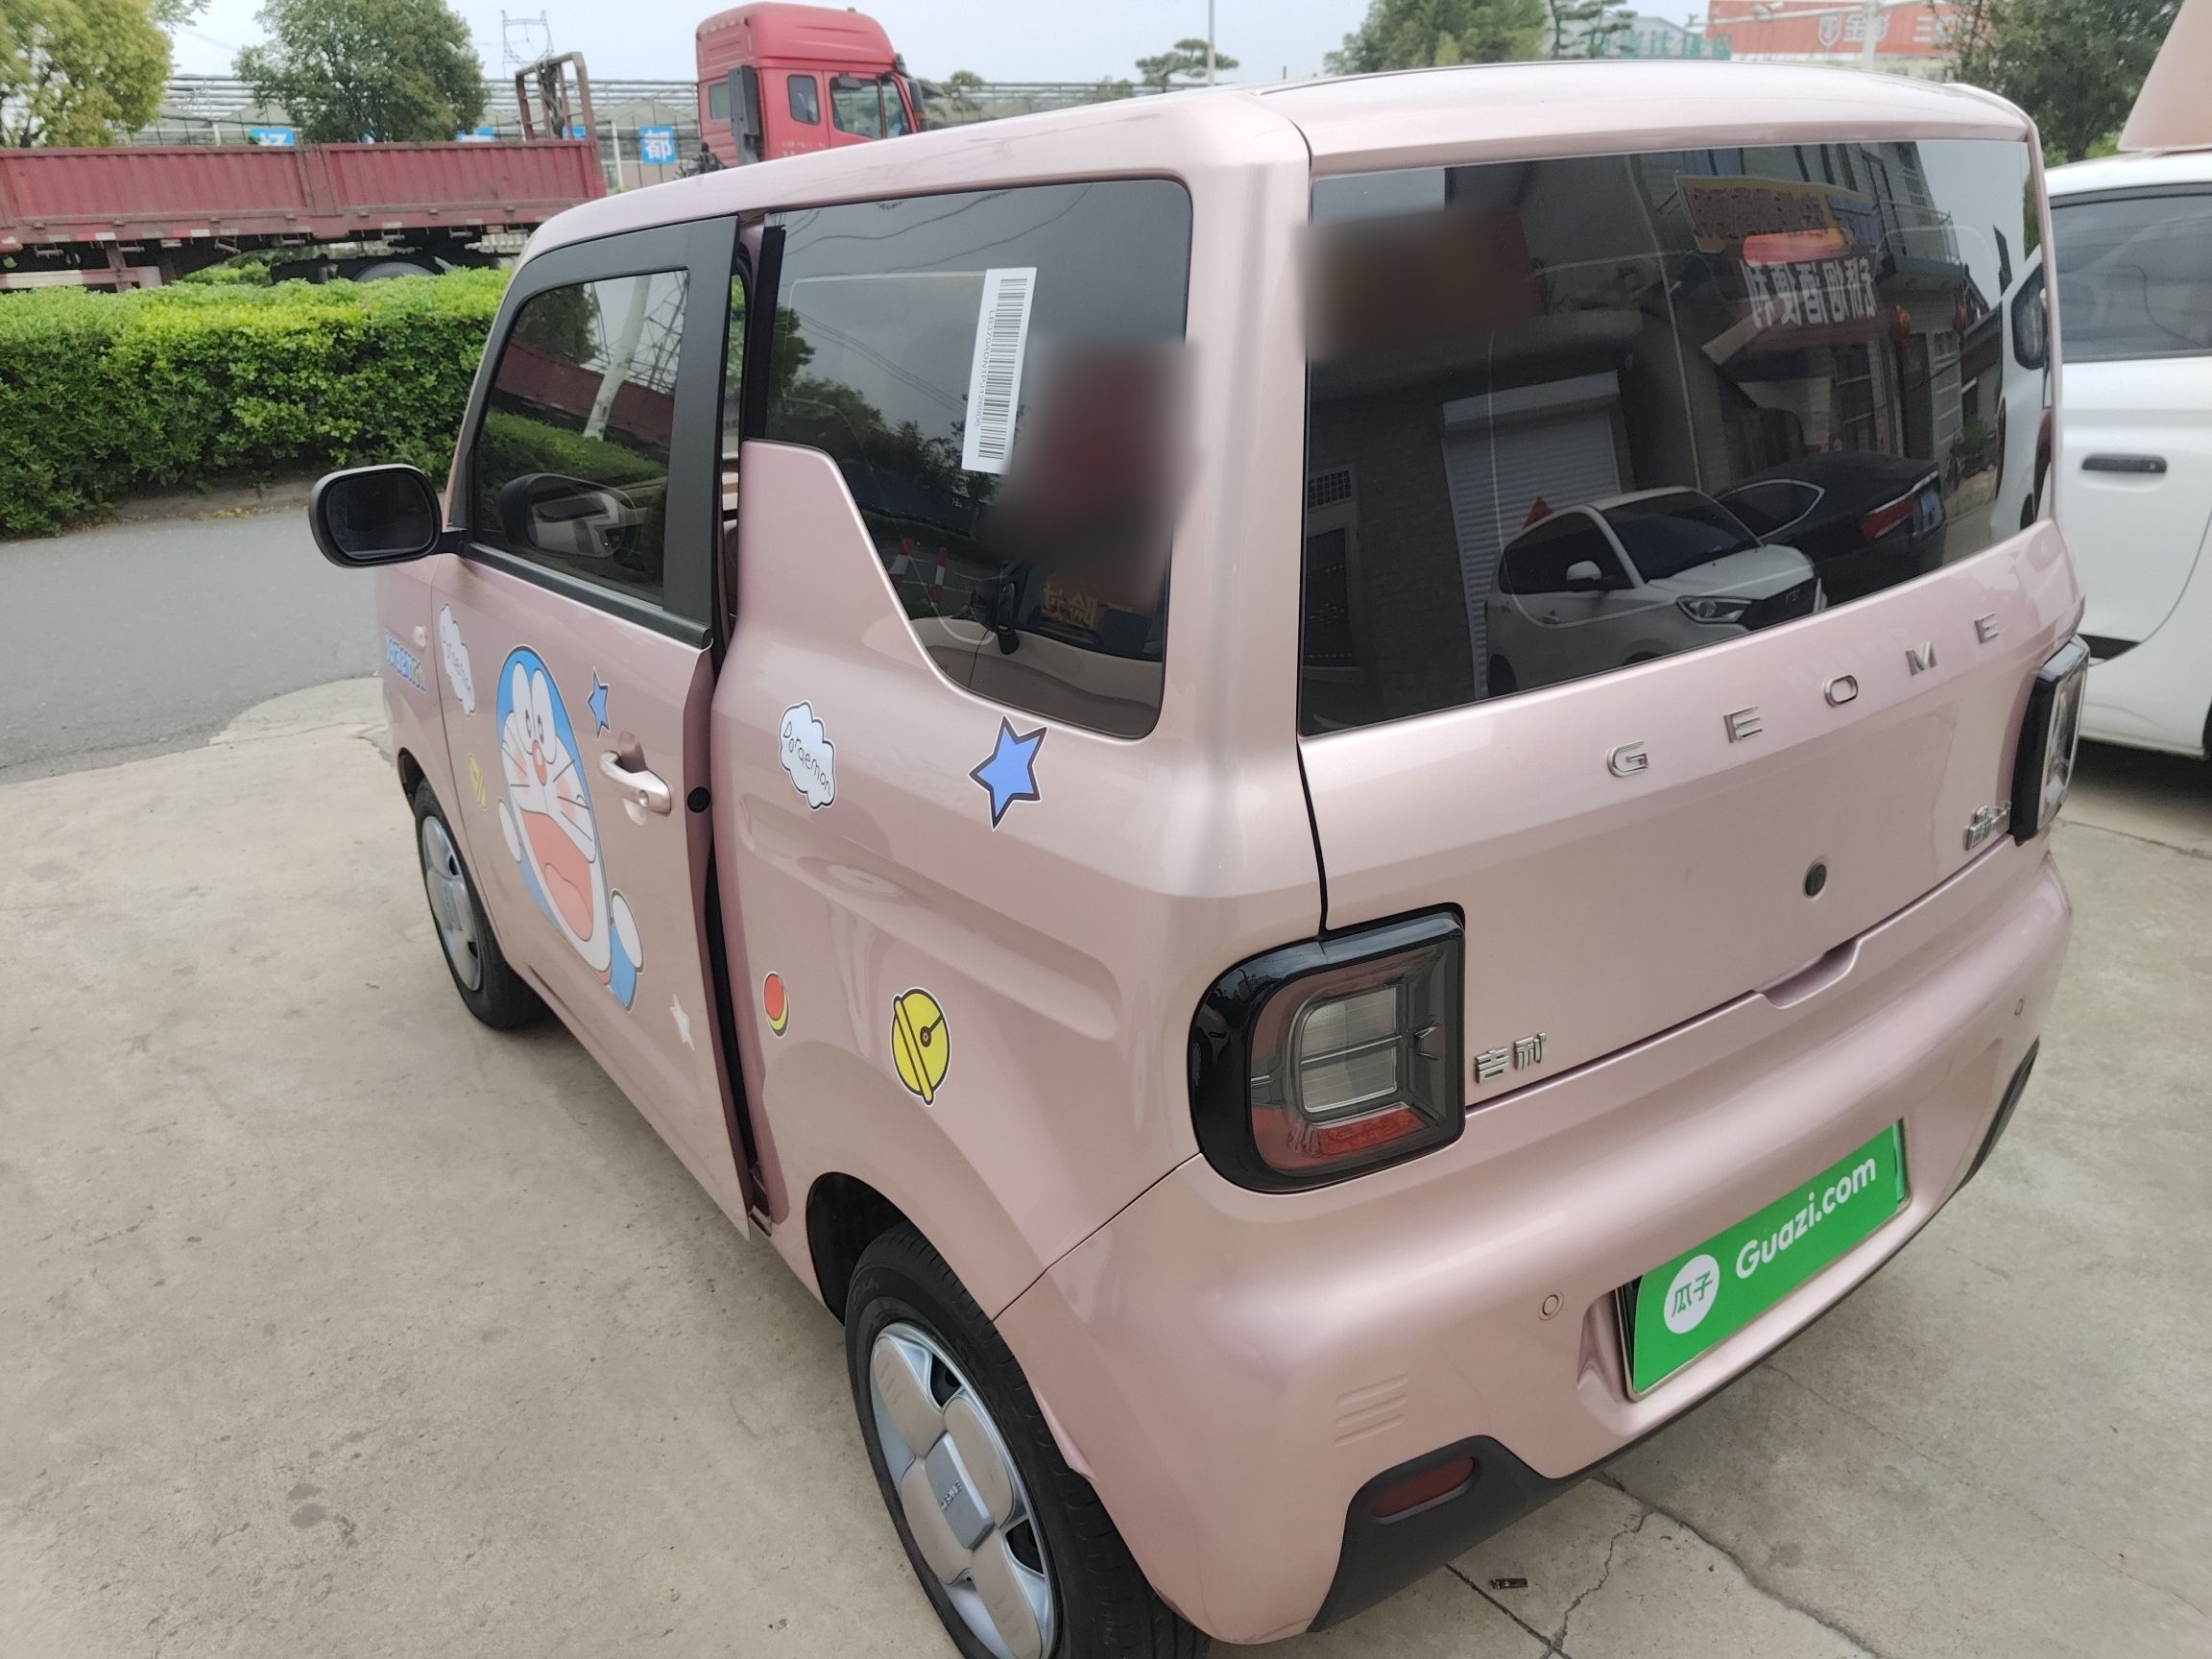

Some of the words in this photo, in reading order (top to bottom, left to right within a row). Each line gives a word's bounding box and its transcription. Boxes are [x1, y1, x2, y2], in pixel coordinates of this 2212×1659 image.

[1606, 612, 1999, 778] GEOME
[783, 721, 831, 797] Doraemon
[1475, 1032, 1548, 1085] 吉利
[1671, 1270, 1714, 1318] 瓜子
[1735, 1157, 1876, 1279] Guazi.com
